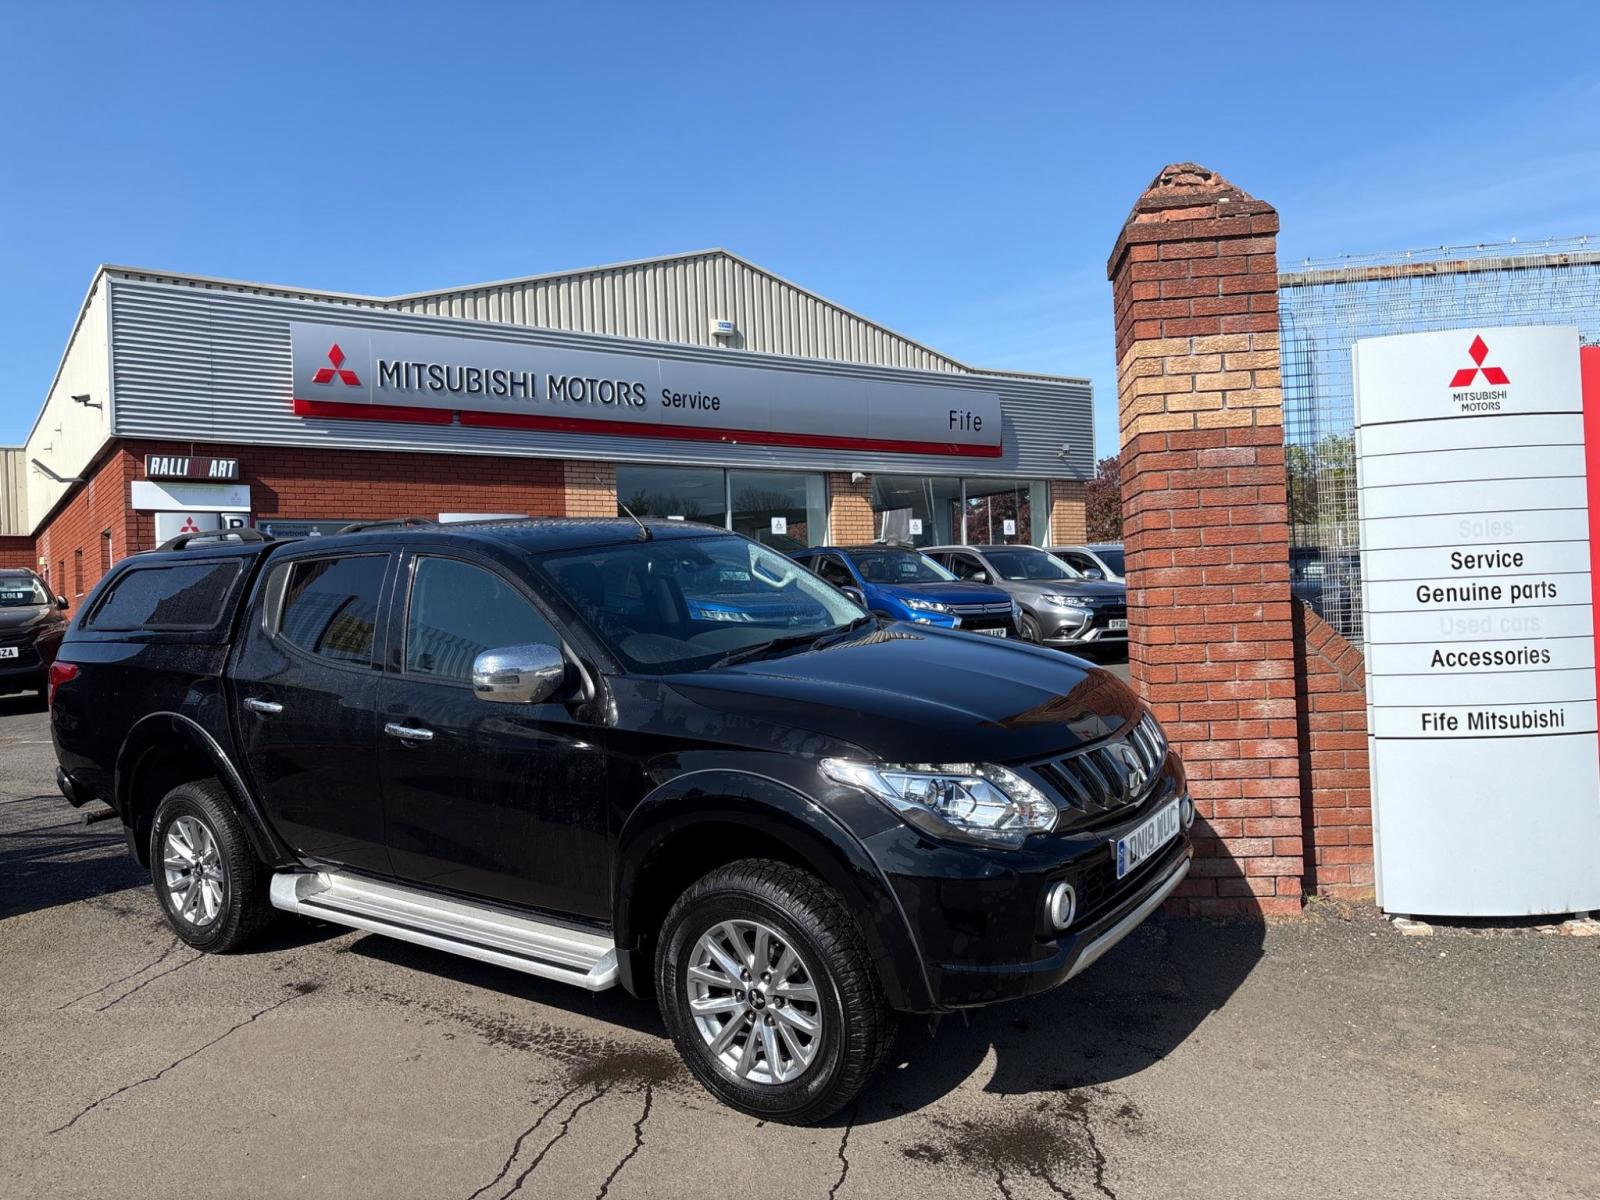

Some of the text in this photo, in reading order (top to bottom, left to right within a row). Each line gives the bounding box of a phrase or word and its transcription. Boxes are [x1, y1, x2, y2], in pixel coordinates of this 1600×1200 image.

[378, 358, 721, 411] MITSUBISHI MOTORS Service
[1452, 390, 1507, 402] MITSUBISHI
[1461, 401, 1501, 412] MOTORS
[949, 409, 983, 432] Fife
[1458, 518, 1514, 538] Sales
[1450, 550, 1524, 570] Service
[1416, 581, 1557, 604] Genuine parts
[1440, 614, 1542, 636] Used cars
[1430, 646, 1551, 668] Accessories
[1421, 708, 1565, 731] Fife Mitsubishi
